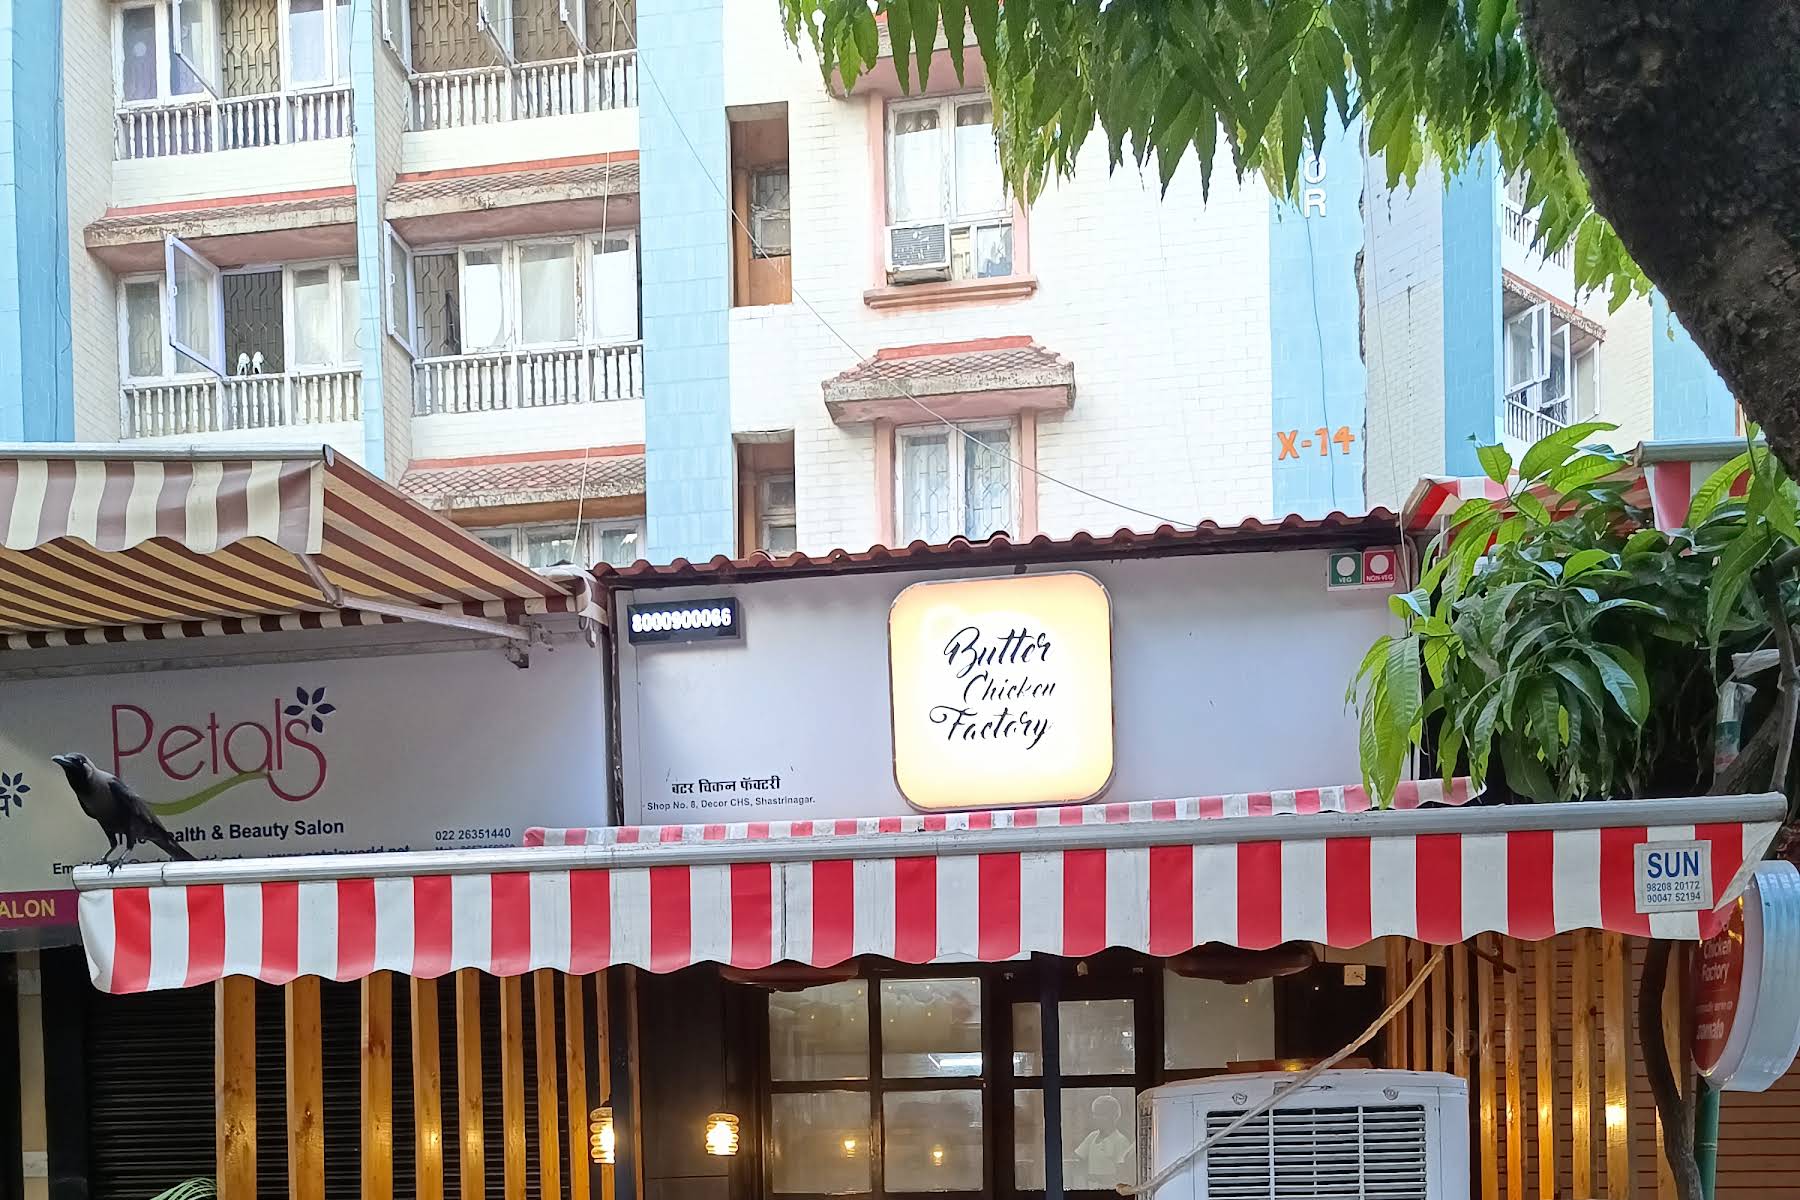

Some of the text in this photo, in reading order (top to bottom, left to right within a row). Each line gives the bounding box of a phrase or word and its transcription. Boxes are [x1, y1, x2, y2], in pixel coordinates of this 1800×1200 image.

[1277, 426, 1355, 460] X-14
[1366, 574, 1394, 582] NON-VEG
[944, 626, 1051, 679] Butter
[963, 670, 1056, 704] Chicken
[929, 705, 1049, 750] Factory
[111, 698, 327, 802] Petals
[699, 779, 737, 793] चिकन
[647, 802, 671, 811] Shop
[673, 801, 688, 810] No.
[701, 799, 728, 808] Decor
[730, 798, 753, 808] CHS,
[755, 796, 816, 806] Shastrinagar.
[211, 825, 224, 840] &
[229, 822, 289, 840] Beauty
[294, 819, 344, 835] Salon
[435, 828, 511, 841] 022 26351440
[1647, 850, 1699, 879] SUN
[1646, 881, 1700, 892] 98208 20172
[1647, 892, 1701, 903] 90047 52194
